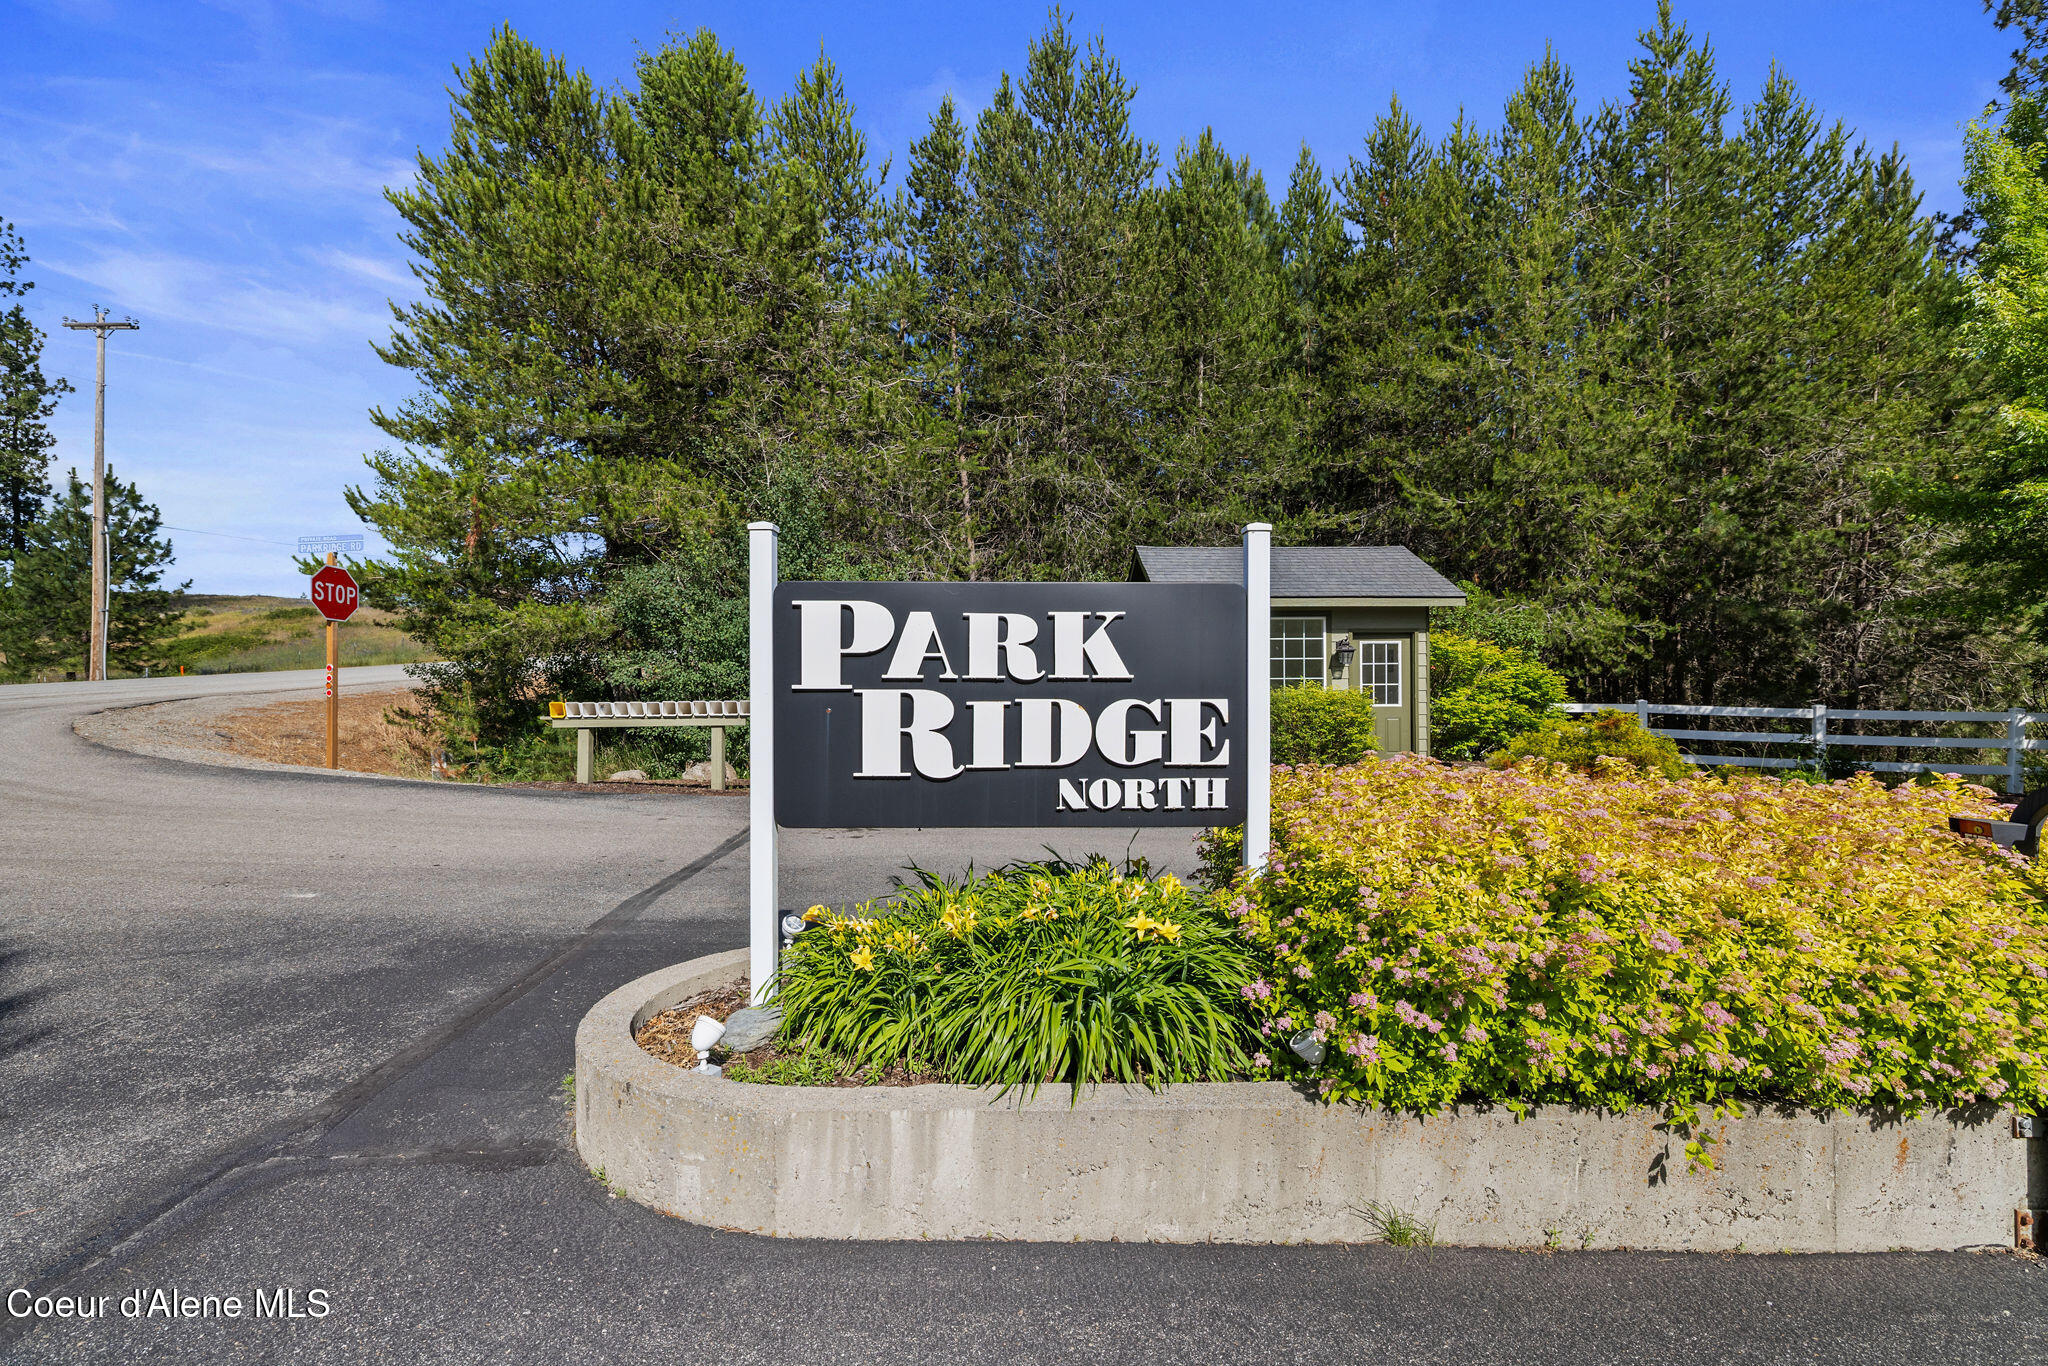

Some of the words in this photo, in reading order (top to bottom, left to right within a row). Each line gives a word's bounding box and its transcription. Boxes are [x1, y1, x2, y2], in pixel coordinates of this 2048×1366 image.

[301, 543, 347, 553] PARKRIDGE
[351, 542, 361, 551] RD
[314, 581, 356, 605] STOP
[791, 600, 1135, 690] PARK
[853, 688, 1230, 780] RIDGE
[1056, 778, 1230, 811] NORTH
